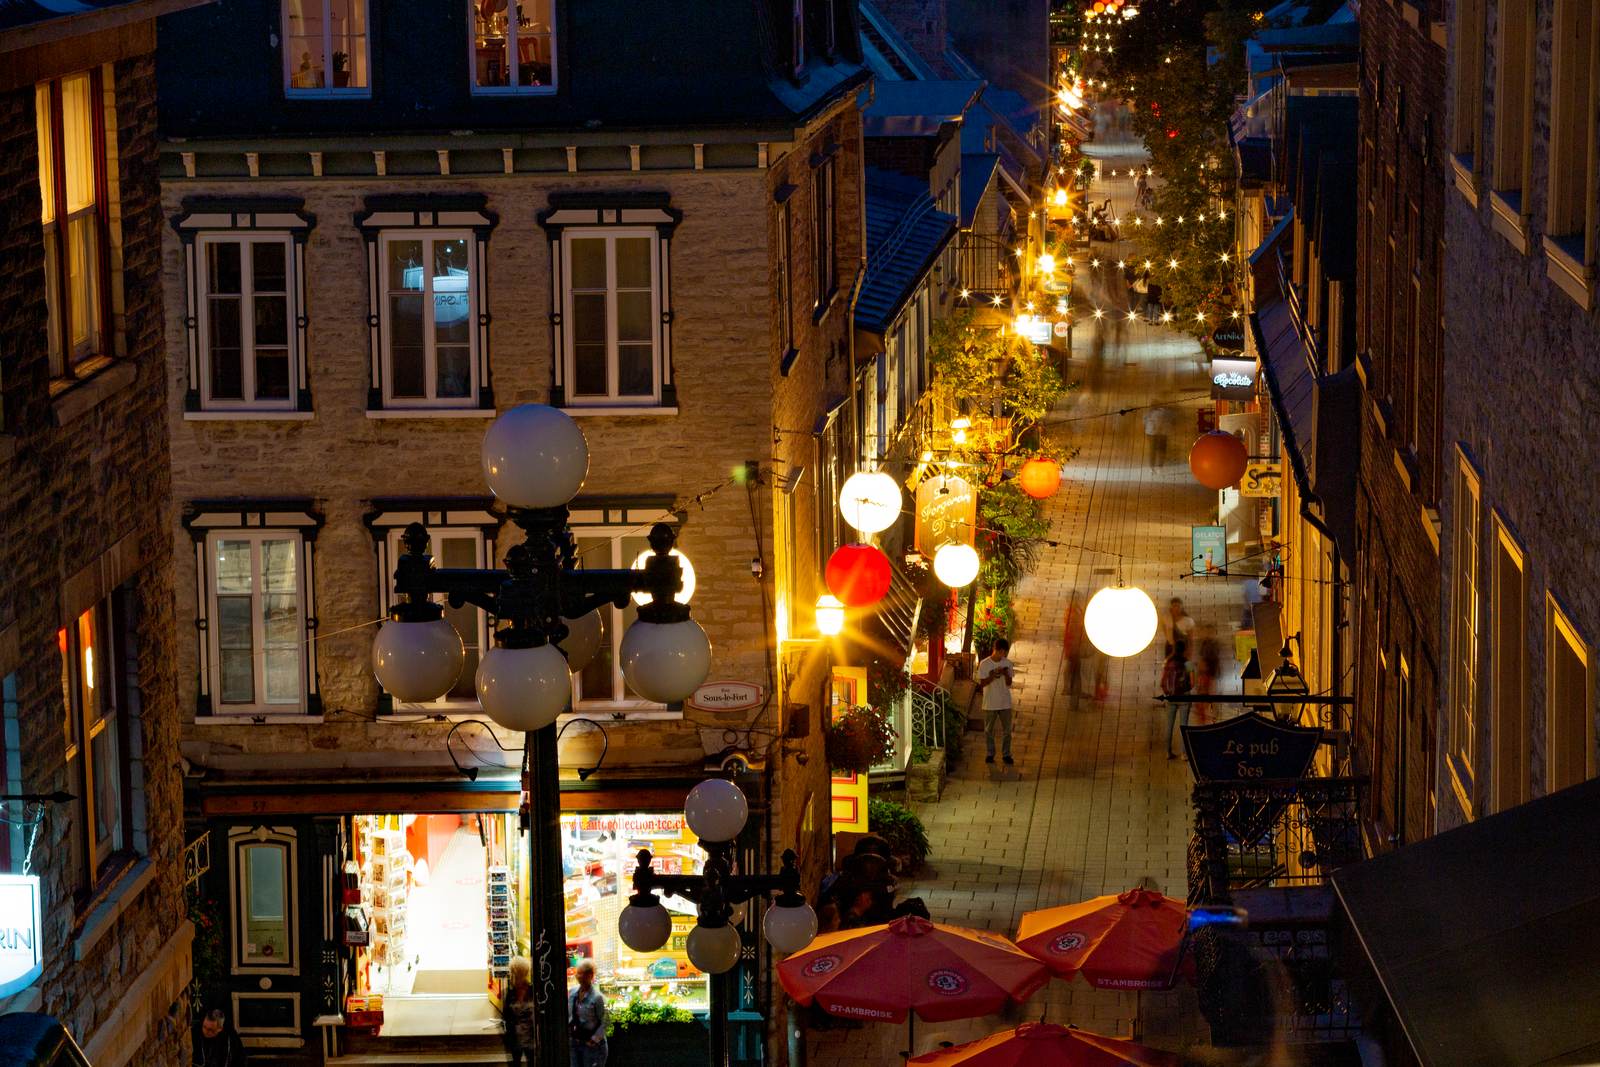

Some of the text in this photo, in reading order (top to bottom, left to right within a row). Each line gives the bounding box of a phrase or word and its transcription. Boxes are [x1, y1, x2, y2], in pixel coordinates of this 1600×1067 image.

[703, 693, 748, 703] Sous-le-Fort
[1222, 737, 1279, 759] Le pub
[829, 1004, 893, 1019] ST-AMBROISE
